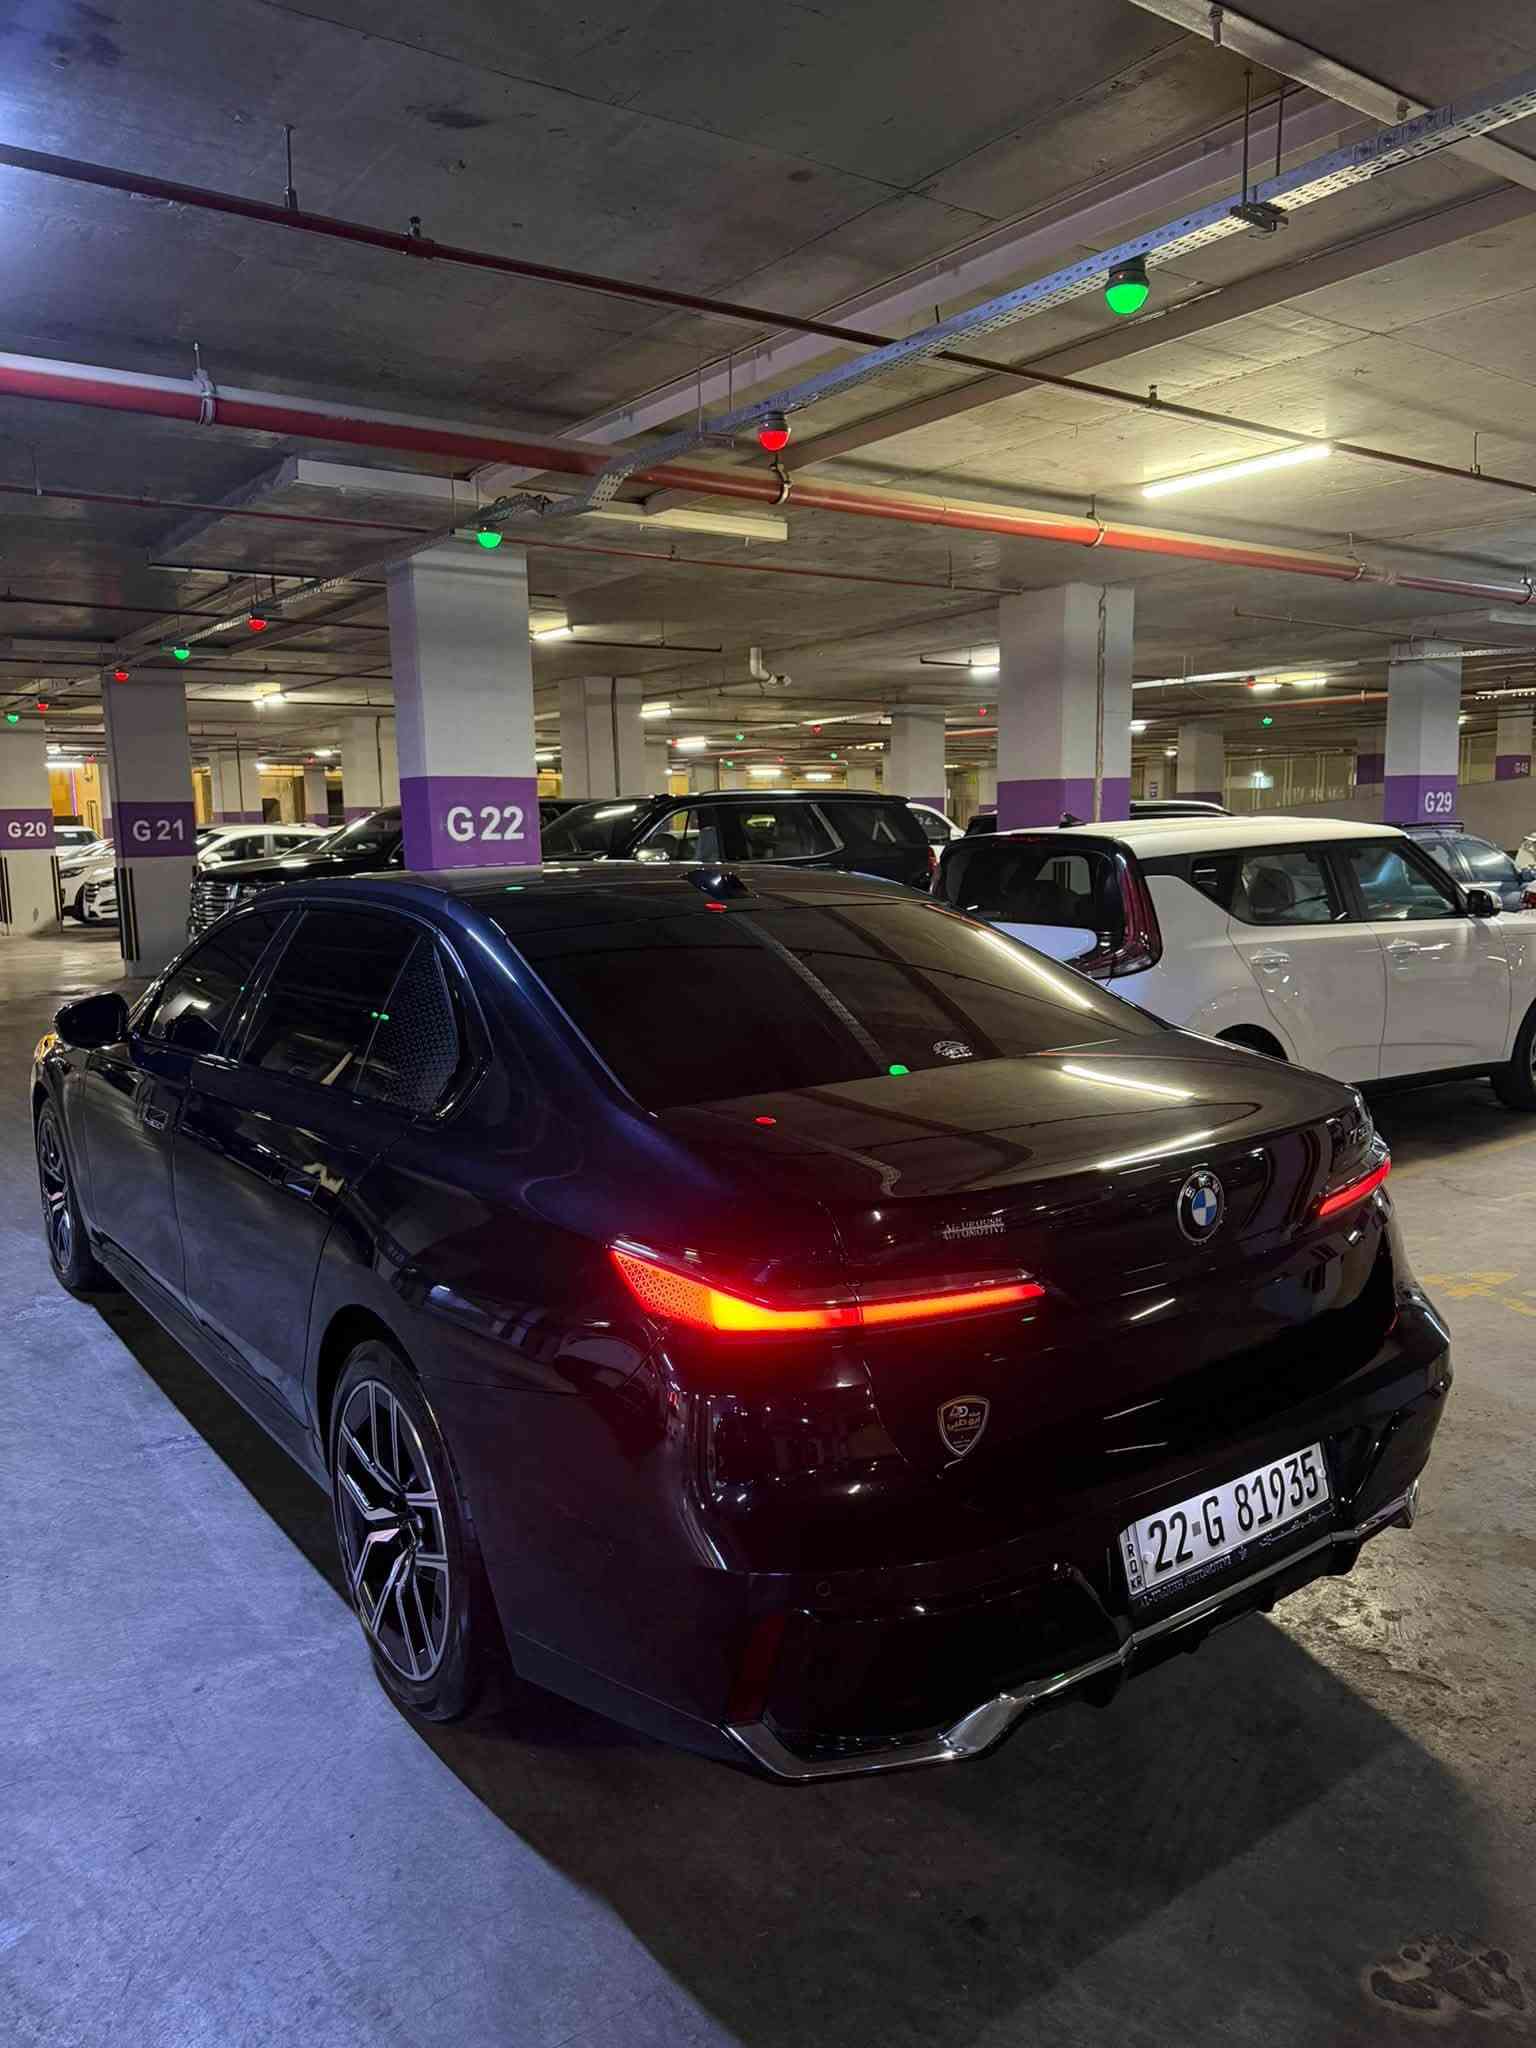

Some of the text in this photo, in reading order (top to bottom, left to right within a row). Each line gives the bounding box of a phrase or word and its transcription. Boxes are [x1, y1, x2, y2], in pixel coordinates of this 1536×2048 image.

[1424, 791, 1453, 813] G29
[7, 821, 47, 839] G20
[132, 819, 184, 842] G21
[447, 805, 525, 842] G22
[1234, 1450, 1318, 1531] 81935
